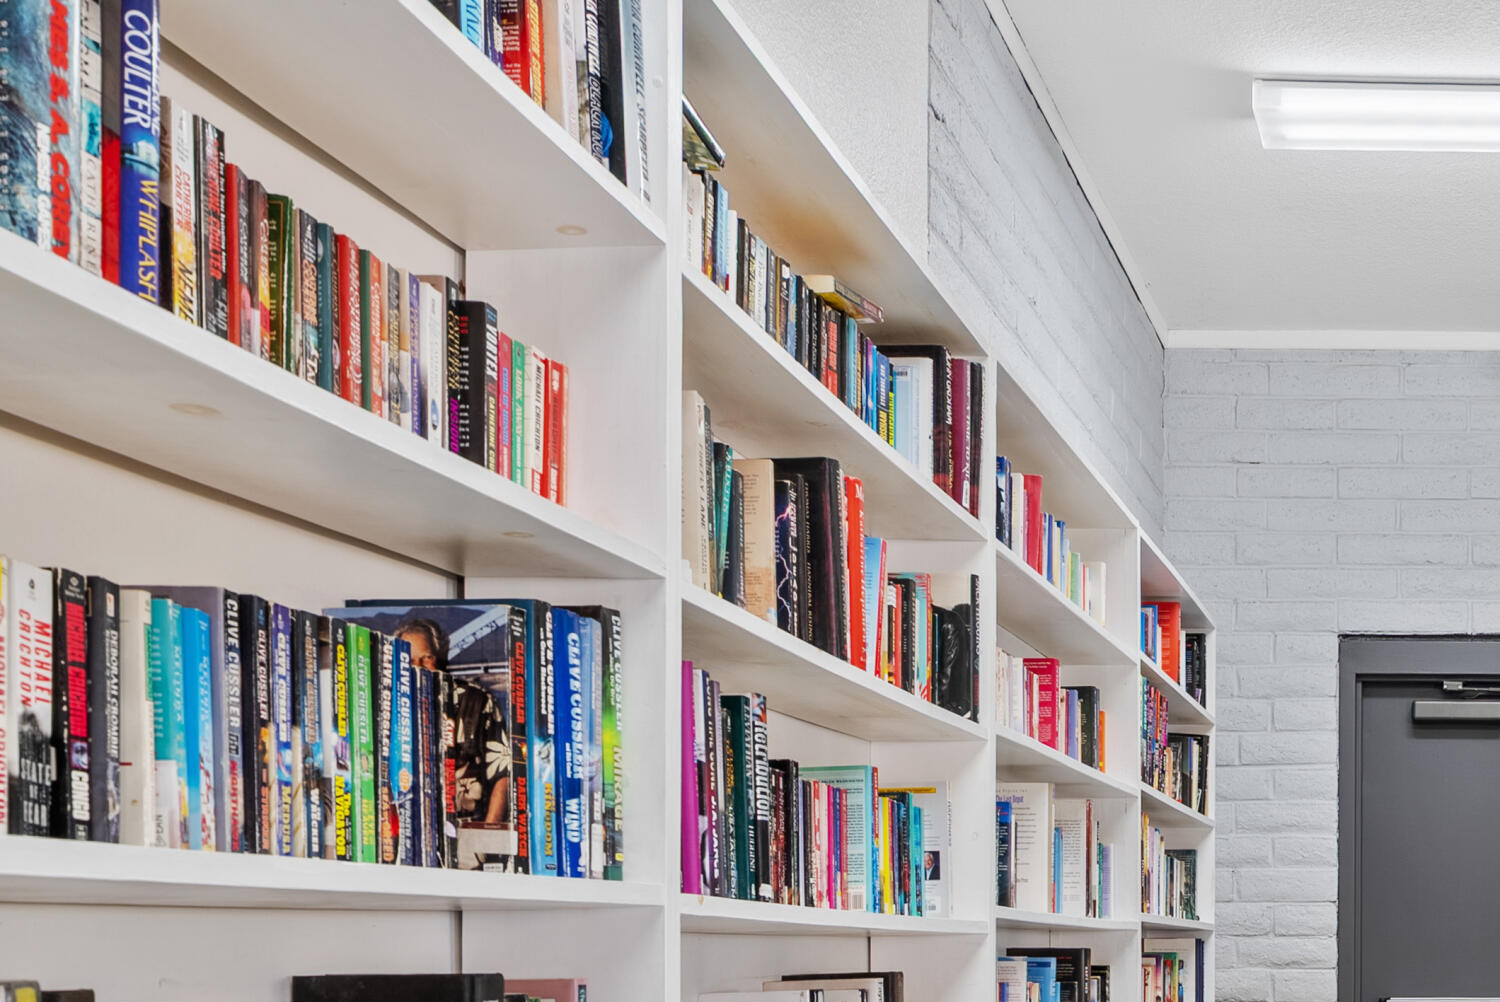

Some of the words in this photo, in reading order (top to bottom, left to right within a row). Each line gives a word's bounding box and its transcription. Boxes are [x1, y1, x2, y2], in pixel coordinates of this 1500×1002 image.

[124, 9, 150, 129] COULTER
[138, 180, 159, 303] WHIPLASH
[65, 602, 86, 664] MICHAEL
[226, 599, 239, 648] CLIVE
[277, 632, 286, 676] CLIVE
[545, 611, 553, 661] CLIVE
[612, 615, 621, 659] CLIVE
[18, 608, 32, 707] CRICHTON
[34, 619, 51, 704] MICHAEL
[110, 629, 119, 694] DEBORAH
[337, 644, 345, 683] CLIVE
[357, 654, 365, 688] CLIVE
[400, 652, 409, 694] CLIVE
[515, 641, 524, 673] CLIVE
[568, 632, 581, 692] CLIVE
[68, 666, 88, 738] CRICHTON
[228, 652, 241, 727] CUSSLER
[278, 678, 288, 742] CUSSLER
[337, 683, 346, 737] CUSSLER
[359, 691, 367, 744] CUSSLER
[516, 676, 525, 724] CUSSLER
[547, 664, 555, 735] CUSSLER
[614, 662, 623, 731] CUSSLER
[706, 676, 714, 717] LONG
[110, 697, 119, 758] CROMBIE
[401, 696, 410, 763] CUSSLER
[570, 692, 585, 779] CUSSLER
[20, 758, 52, 786] STATE
[71, 770, 90, 821] CONGO
[517, 776, 526, 811] DARK
[613, 746, 623, 833] MIRAGE
[709, 751, 717, 790] GONE
[755, 720, 770, 821] Retribution
[230, 759, 240, 851] NIGHTHAWK
[281, 785, 291, 853] MEDUSA
[335, 775, 345, 855] NAVIGATOR
[519, 813, 528, 857] WATCH
[544, 782, 553, 856] KINGDOM
[565, 797, 580, 843] WIND
[712, 828, 720, 879] JANCE
[729, 834, 737, 899] JACKSON
